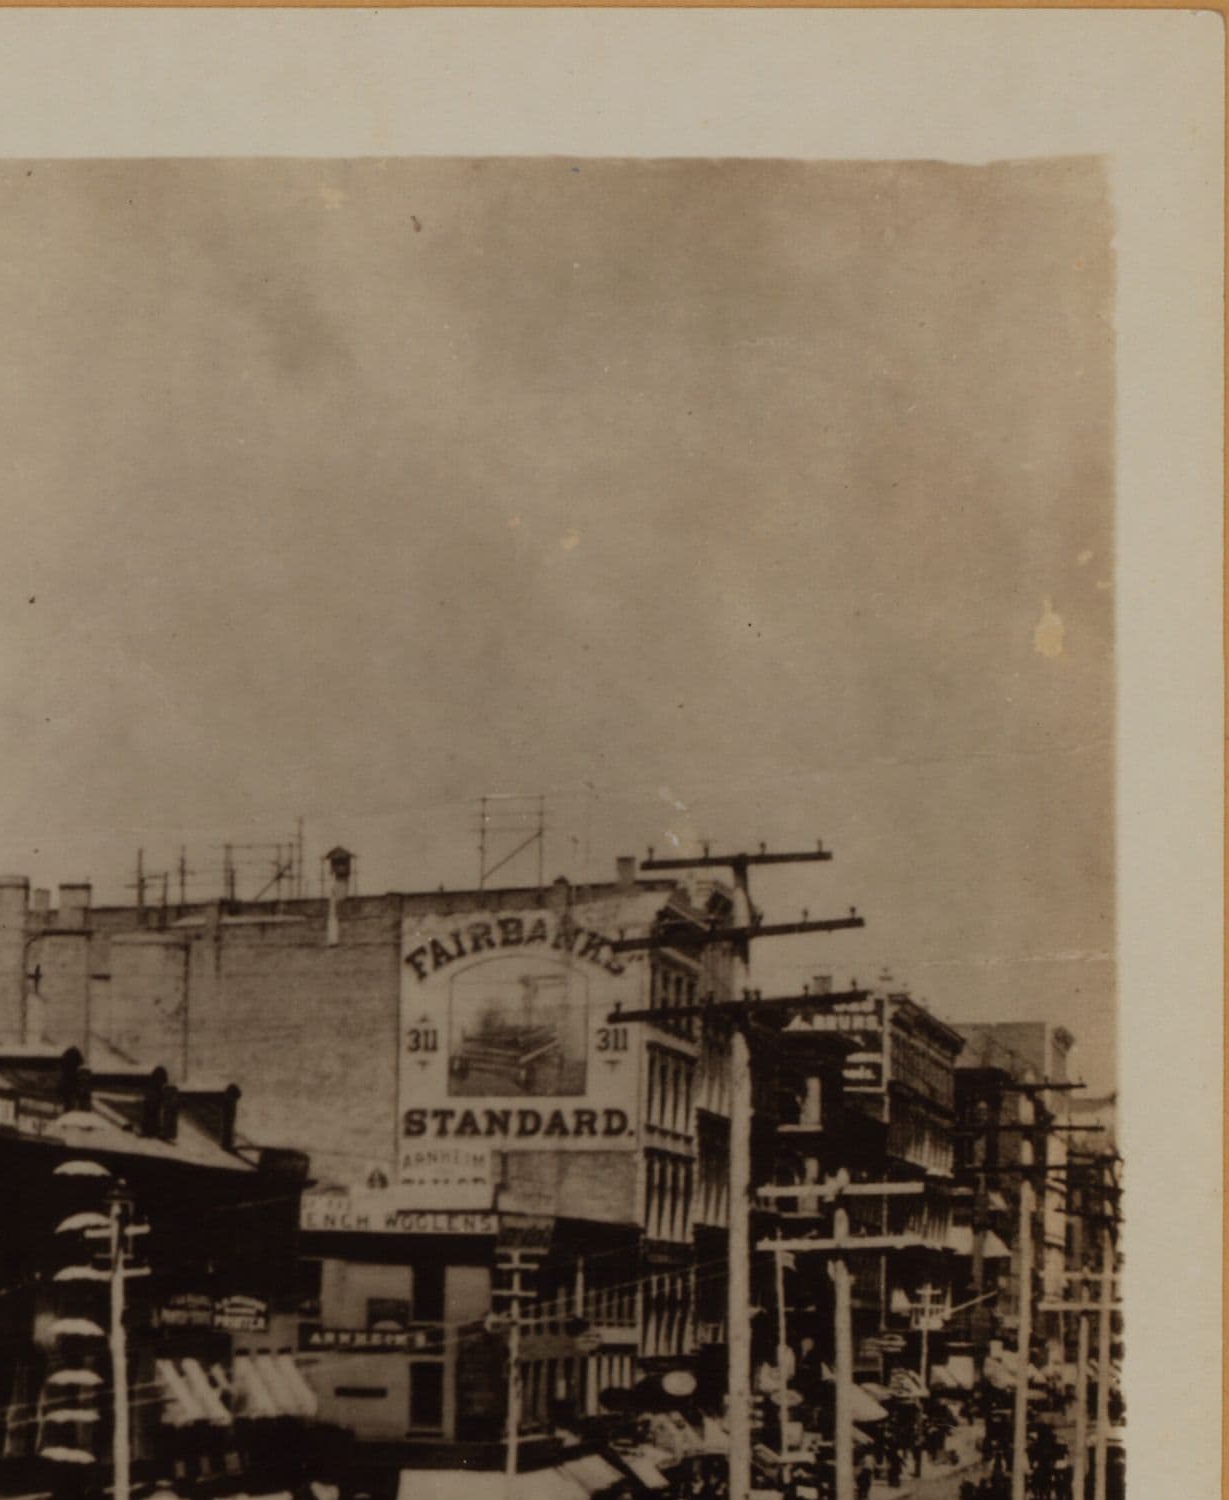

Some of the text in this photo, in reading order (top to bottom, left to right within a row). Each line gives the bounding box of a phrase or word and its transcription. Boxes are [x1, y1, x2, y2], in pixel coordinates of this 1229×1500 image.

[407, 1029, 438, 1053] 311
[597, 1027, 628, 1052] 311
[306, 1213, 369, 1229] ENCH
